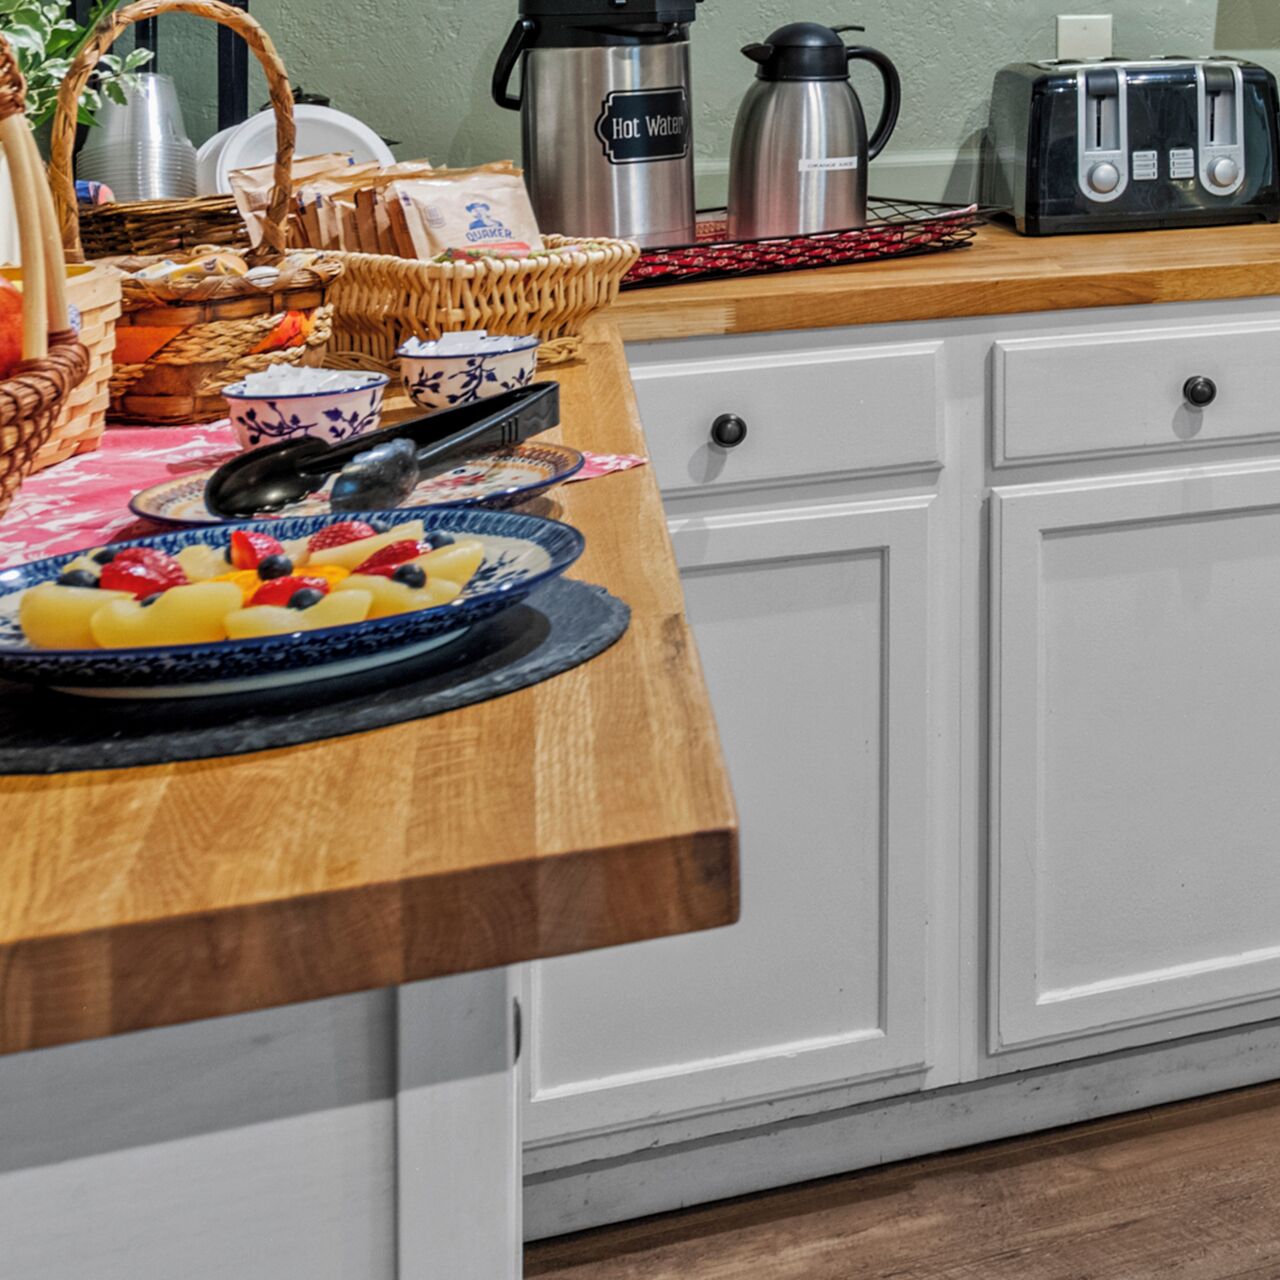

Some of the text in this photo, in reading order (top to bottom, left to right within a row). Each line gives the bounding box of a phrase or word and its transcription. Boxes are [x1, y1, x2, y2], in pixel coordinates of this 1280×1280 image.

[612, 114, 684, 140] Hot Water
[466, 228, 513, 242] QUAKER
